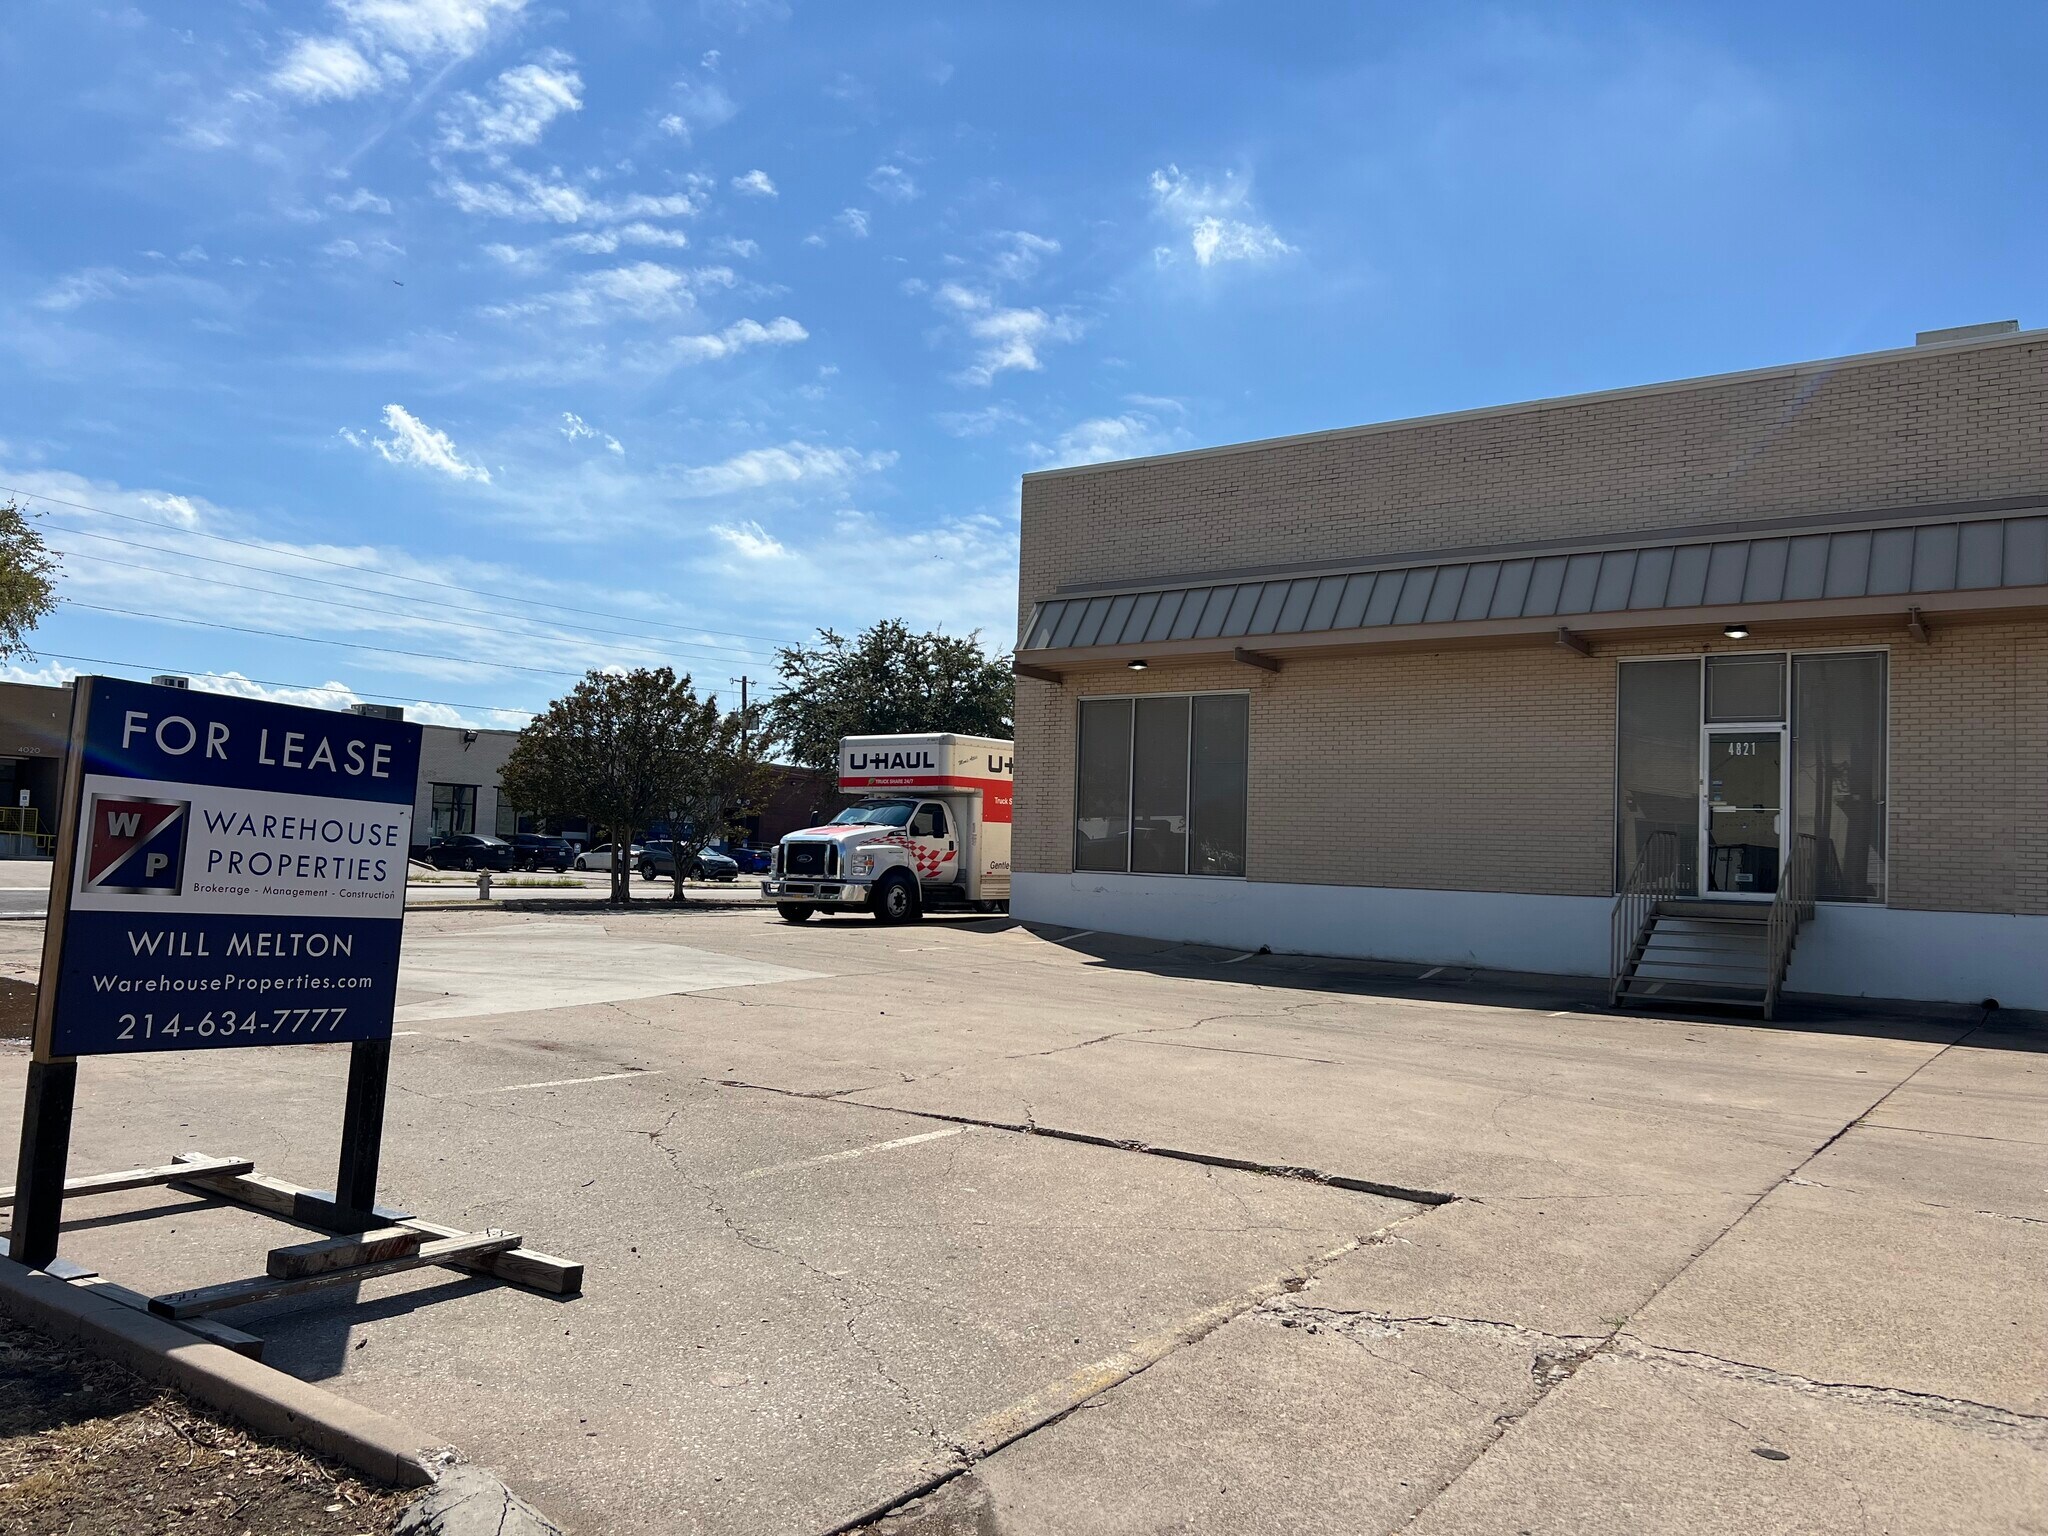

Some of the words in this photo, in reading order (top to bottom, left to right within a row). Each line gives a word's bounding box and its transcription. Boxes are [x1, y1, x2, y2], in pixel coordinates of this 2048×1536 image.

[17, 746, 41, 754] 4020
[122, 710, 230, 760] FOR
[258, 728, 392, 779] LEASE
[1728, 742, 1756, 756] 4821
[850, 751, 935, 770] U-HAUL
[994, 796, 1008, 805] Truck
[107, 811, 141, 838] W
[203, 809, 399, 847] WAREHOUSE
[146, 853, 168, 878] P
[207, 849, 387, 882] PROPERTIES
[193, 883, 250, 894] Brokerage
[263, 886, 328, 898] Management
[339, 889, 395, 900] Construction
[128, 931, 210, 957] WILL
[226, 933, 353, 957] MELTON
[93, 973, 373, 994] WarehouseProperties.com
[116, 1008, 348, 1040] 214-634-7777
